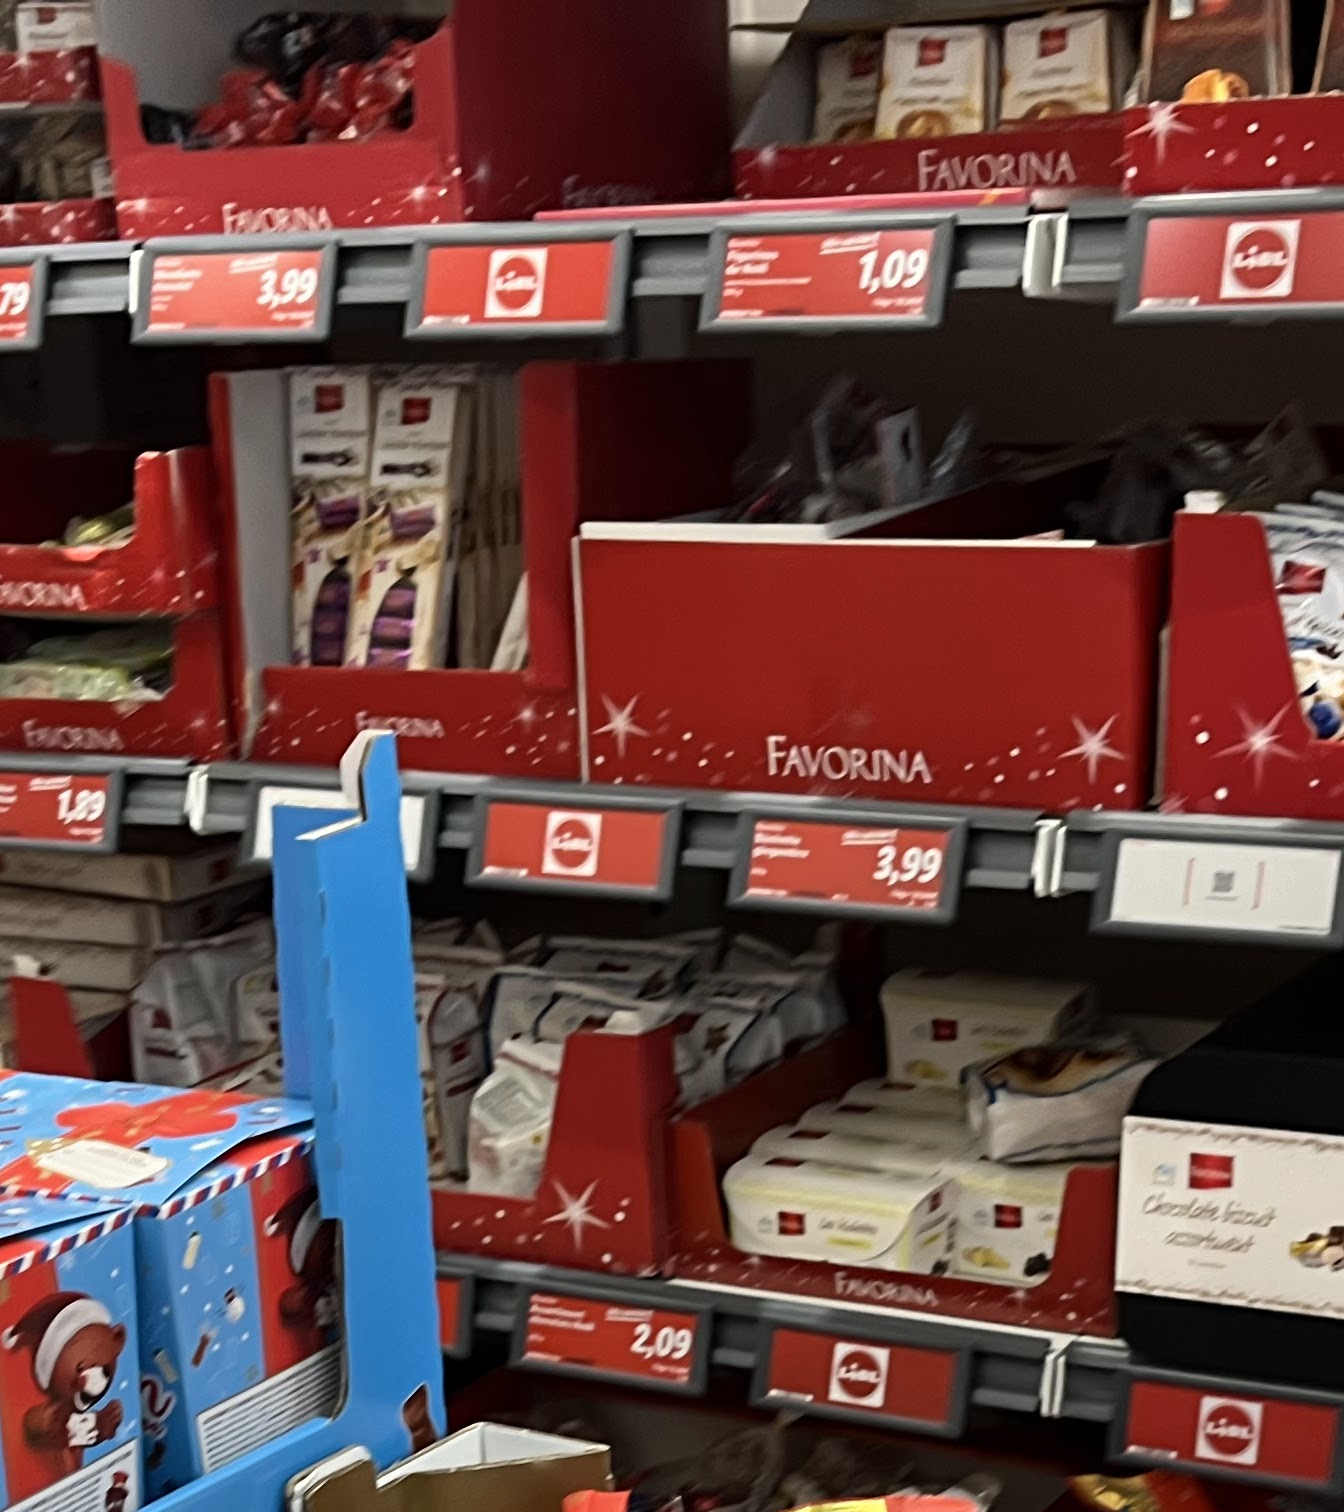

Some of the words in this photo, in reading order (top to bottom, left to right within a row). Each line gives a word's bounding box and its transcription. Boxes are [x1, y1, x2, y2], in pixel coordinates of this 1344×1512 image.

[918, 148, 1075, 190] FAVORINA
[258, 267, 318, 311] 3,99
[859, 248, 929, 294] 1,09
[766, 734, 933, 784] FAVORINA
[872, 845, 943, 886] 3,99
[629, 1322, 693, 1360] 2,09
